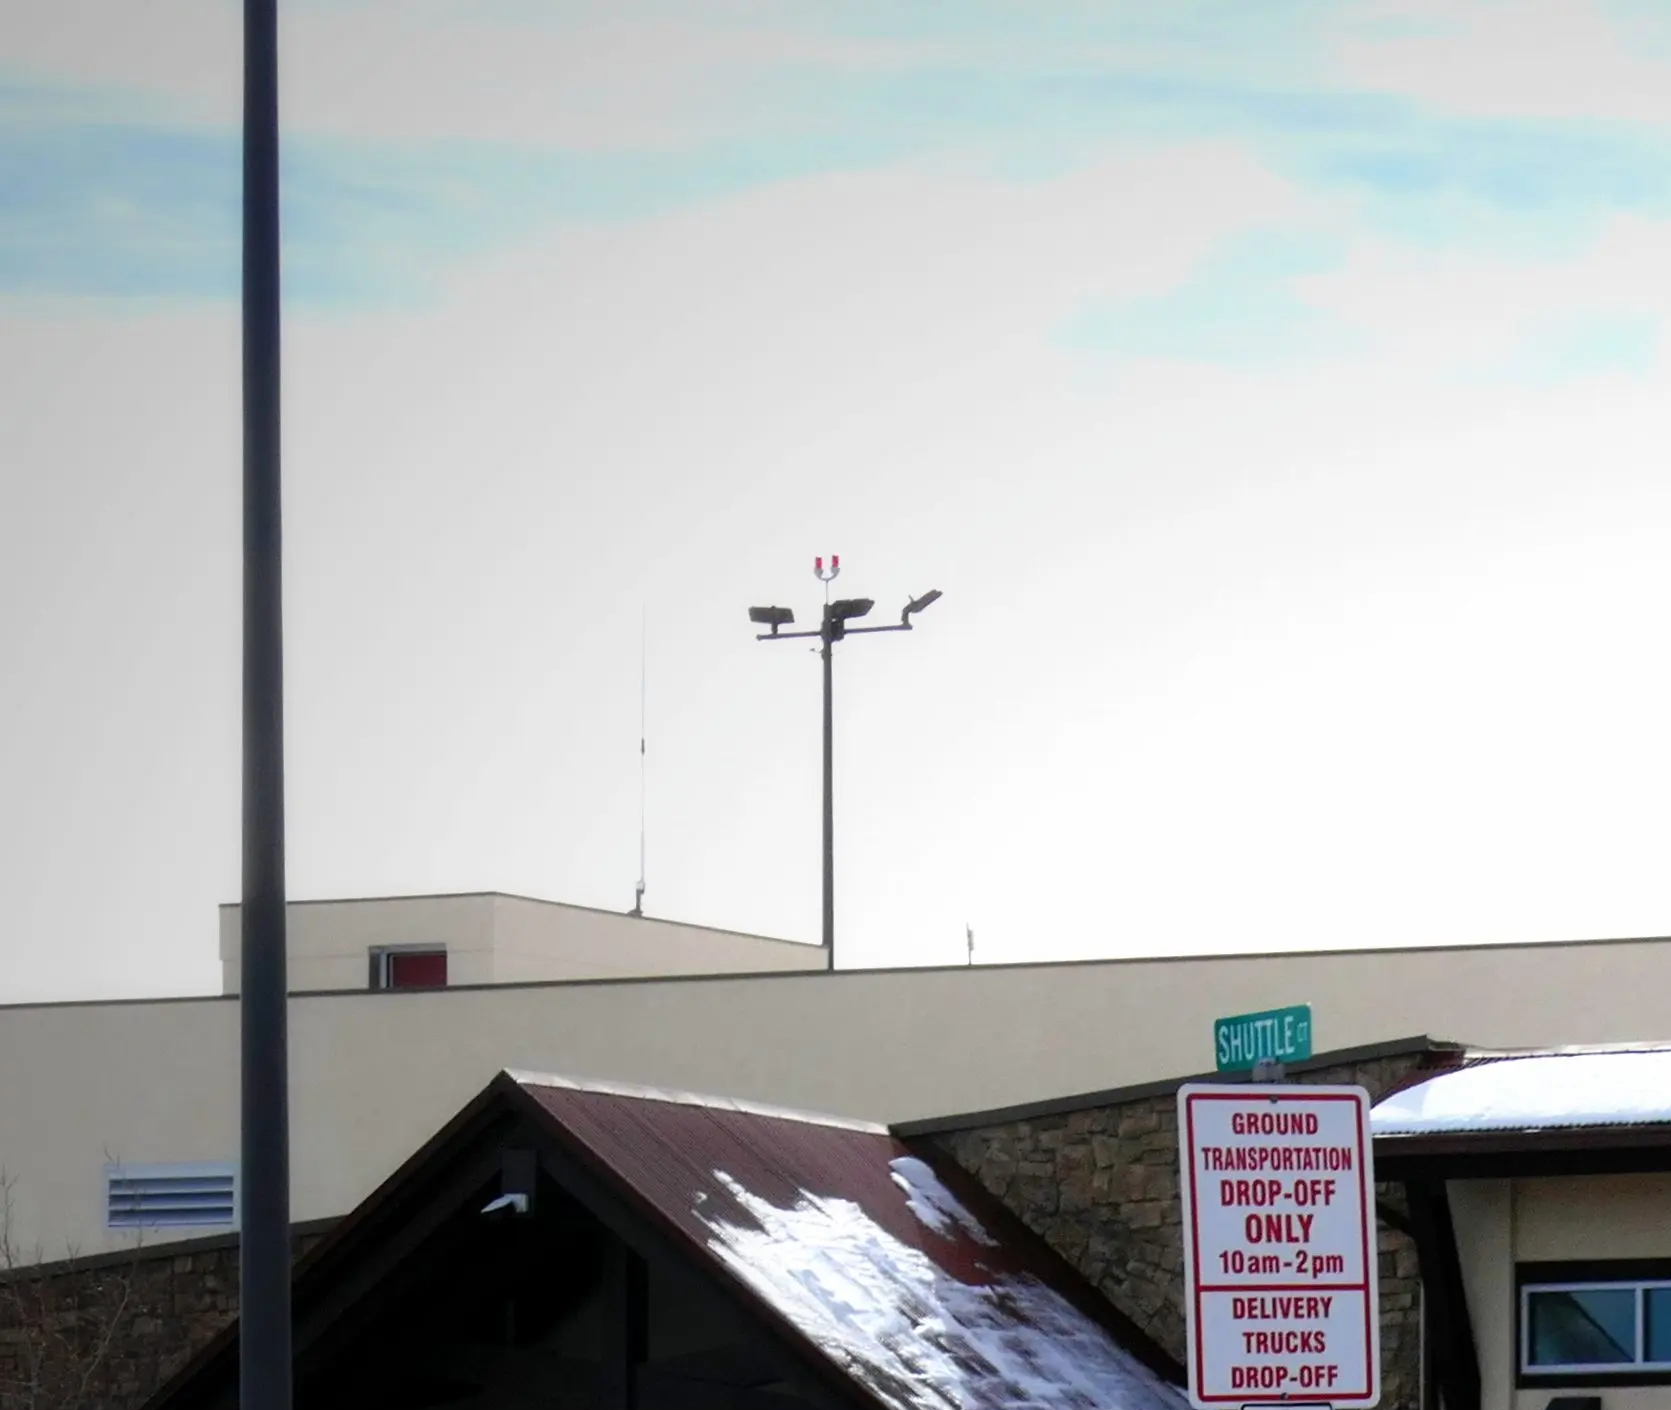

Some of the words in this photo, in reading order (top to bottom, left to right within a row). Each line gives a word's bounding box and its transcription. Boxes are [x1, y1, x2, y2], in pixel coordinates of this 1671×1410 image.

[1219, 1016, 1295, 1064] SHUTTLE
[1231, 1113, 1318, 1135] GROUND
[1202, 1147, 1352, 1171] TRANSPORTATION
[1220, 1179, 1336, 1206] DROP-OFF
[1245, 1214, 1314, 1244] ONLY
[1232, 1297, 1333, 1320] DELIVERY
[1242, 1331, 1326, 1354] TRUCKS
[1231, 1365, 1338, 1389] DROP-OFF
